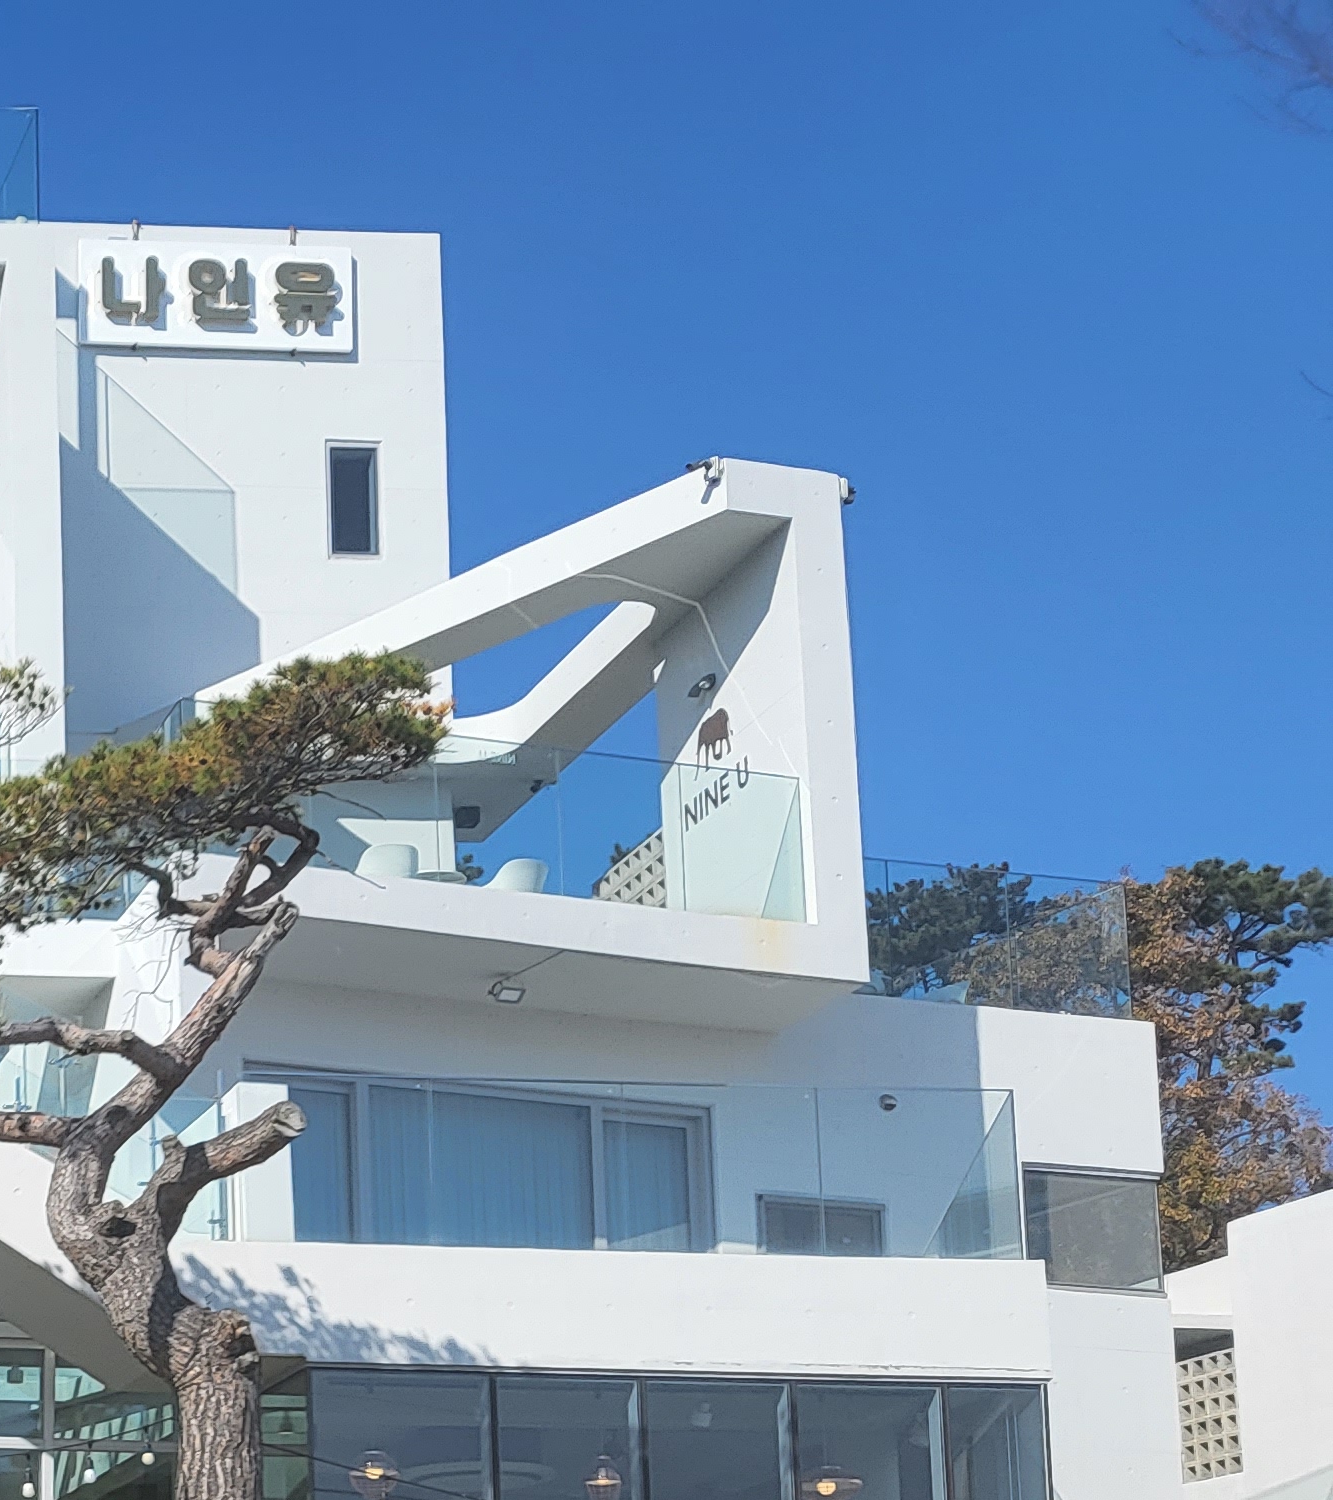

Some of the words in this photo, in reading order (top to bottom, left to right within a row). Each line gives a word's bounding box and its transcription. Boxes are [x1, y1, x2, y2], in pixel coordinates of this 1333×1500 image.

[101, 254, 336, 334] 나인유
[684, 770, 730, 832] NINE
[735, 754, 749, 789] U
